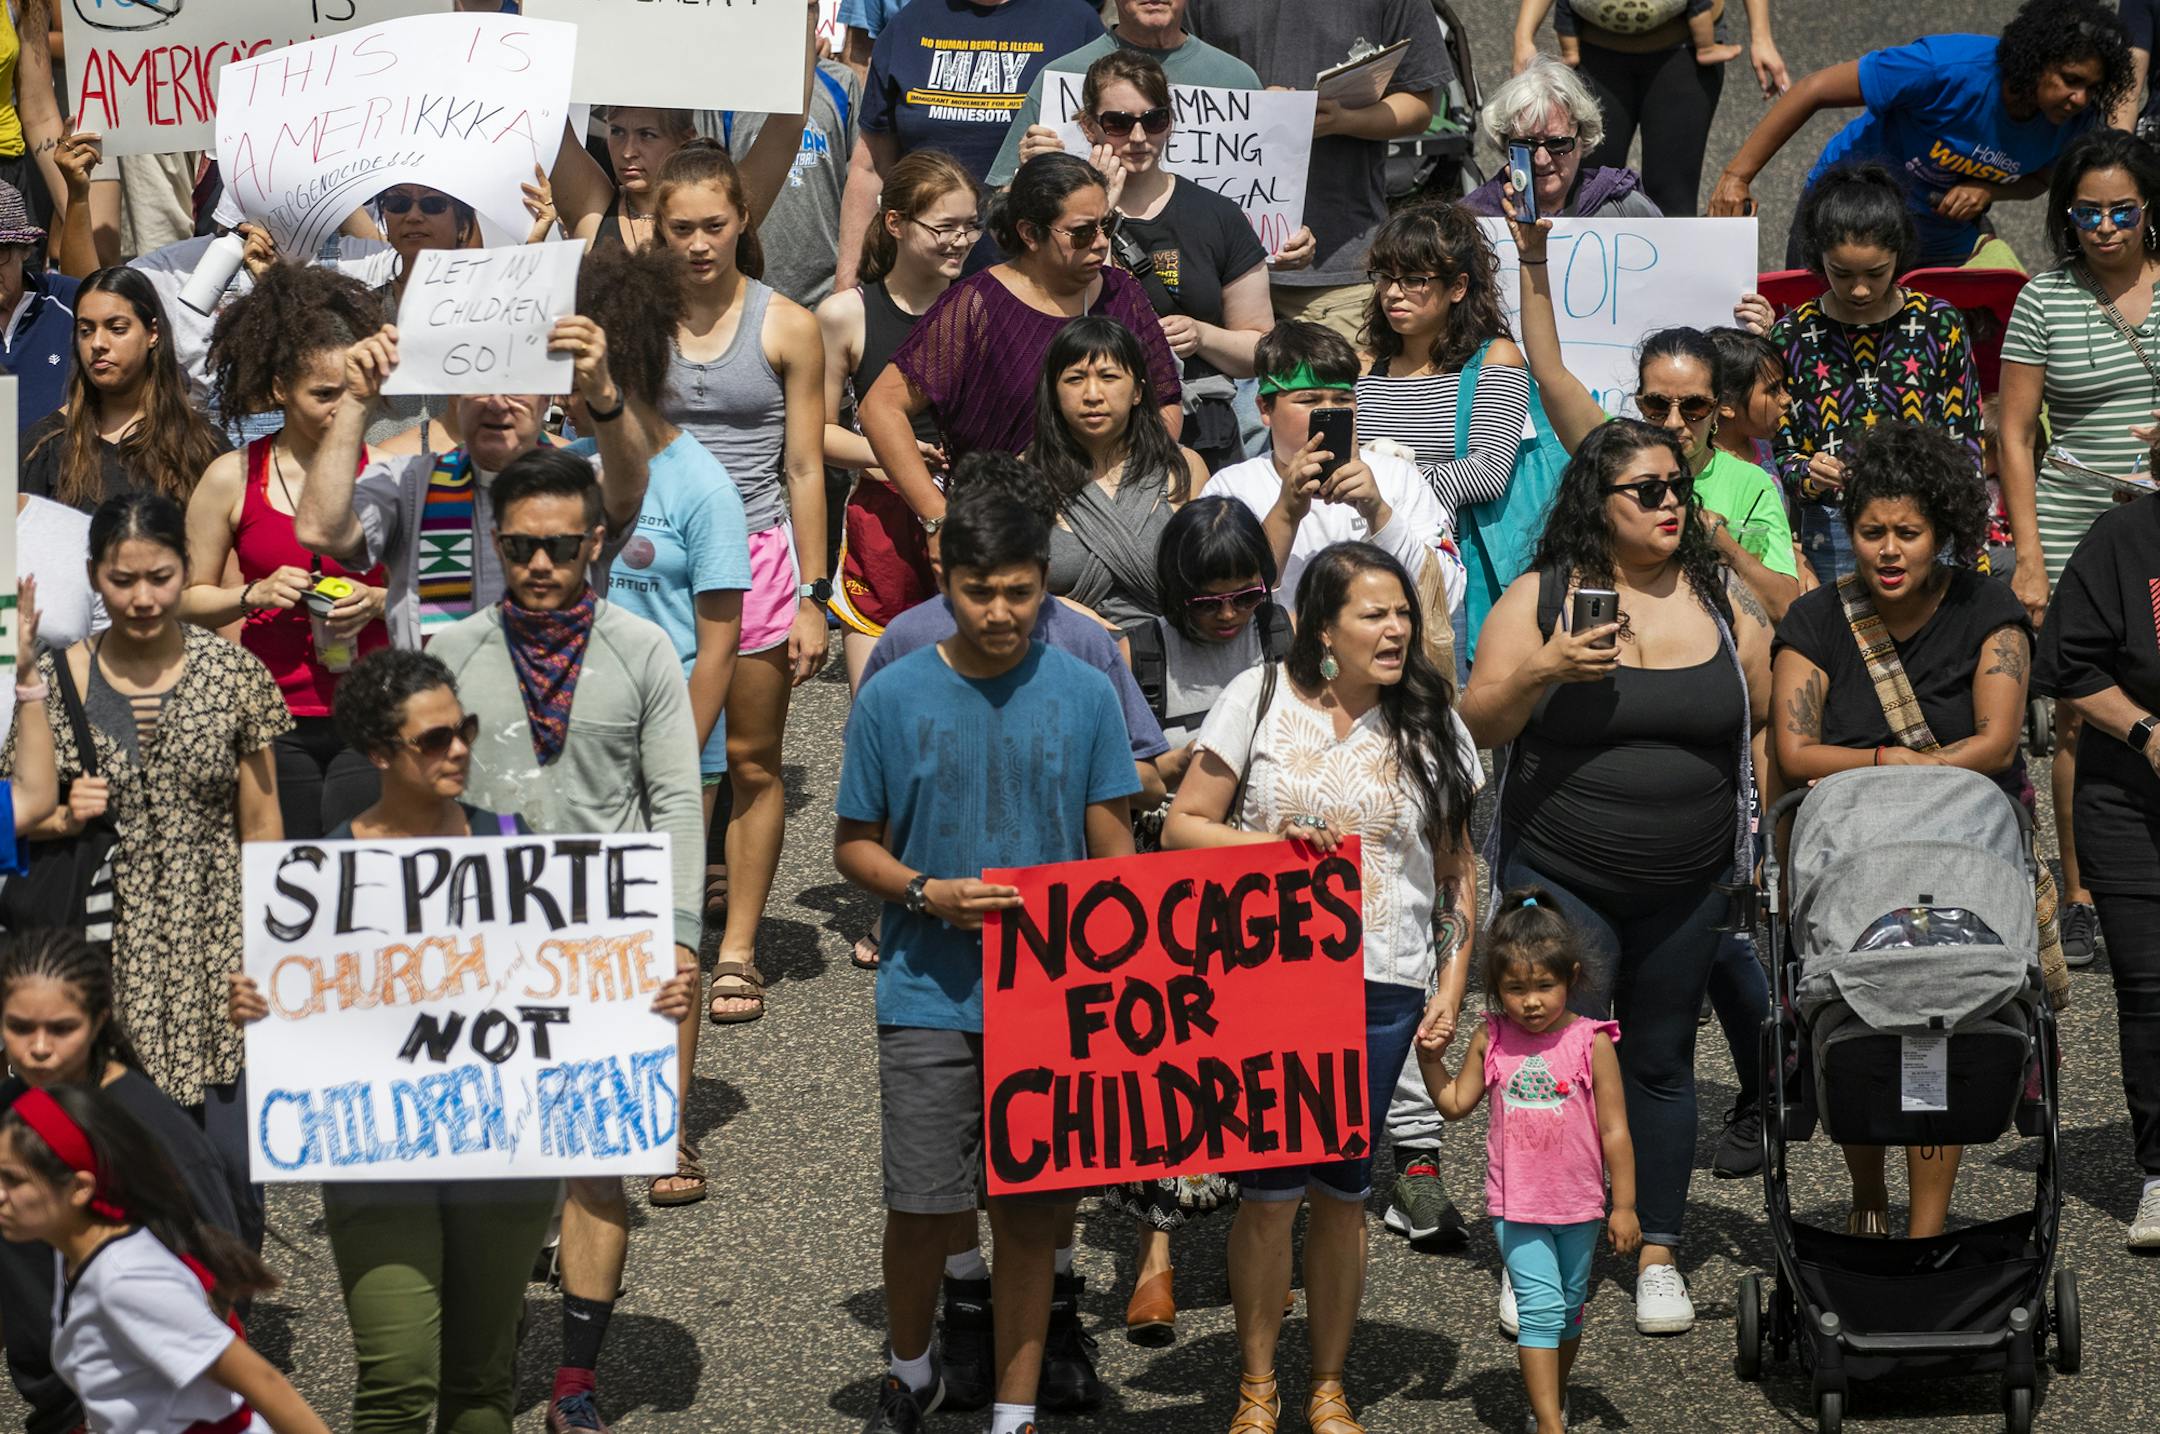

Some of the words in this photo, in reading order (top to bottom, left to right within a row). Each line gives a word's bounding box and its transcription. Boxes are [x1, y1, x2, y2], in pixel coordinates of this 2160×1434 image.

[236, 33, 398, 107] THIS
[468, 27, 532, 73] IS
[920, 37, 935, 49] NO
[935, 39, 969, 50] HUMAN
[969, 40, 998, 51] BEING
[999, 41, 1009, 52] IS
[1010, 42, 1044, 53] ILLEGAL
[911, 94, 949, 104] IMMIGRANT
[951, 98, 990, 107] MOVEMENT
[928, 105, 1012, 123] MINNESOTA
[1971, 143, 2021, 173] Hollies
[498, 250, 544, 290] MY
[429, 295, 551, 327] CHILDREN
[264, 839, 664, 943] SEPARTE
[997, 875, 1149, 991] NO
[1157, 856, 1363, 977] CAGES
[269, 931, 490, 1021] CHURCH
[524, 929, 661, 1004] STATE
[397, 1005, 571, 1065] NOT
[1064, 975, 1220, 1060] FOR
[258, 1063, 510, 1171] CHILDREN
[987, 1047, 1370, 1184] CHILDREN!
